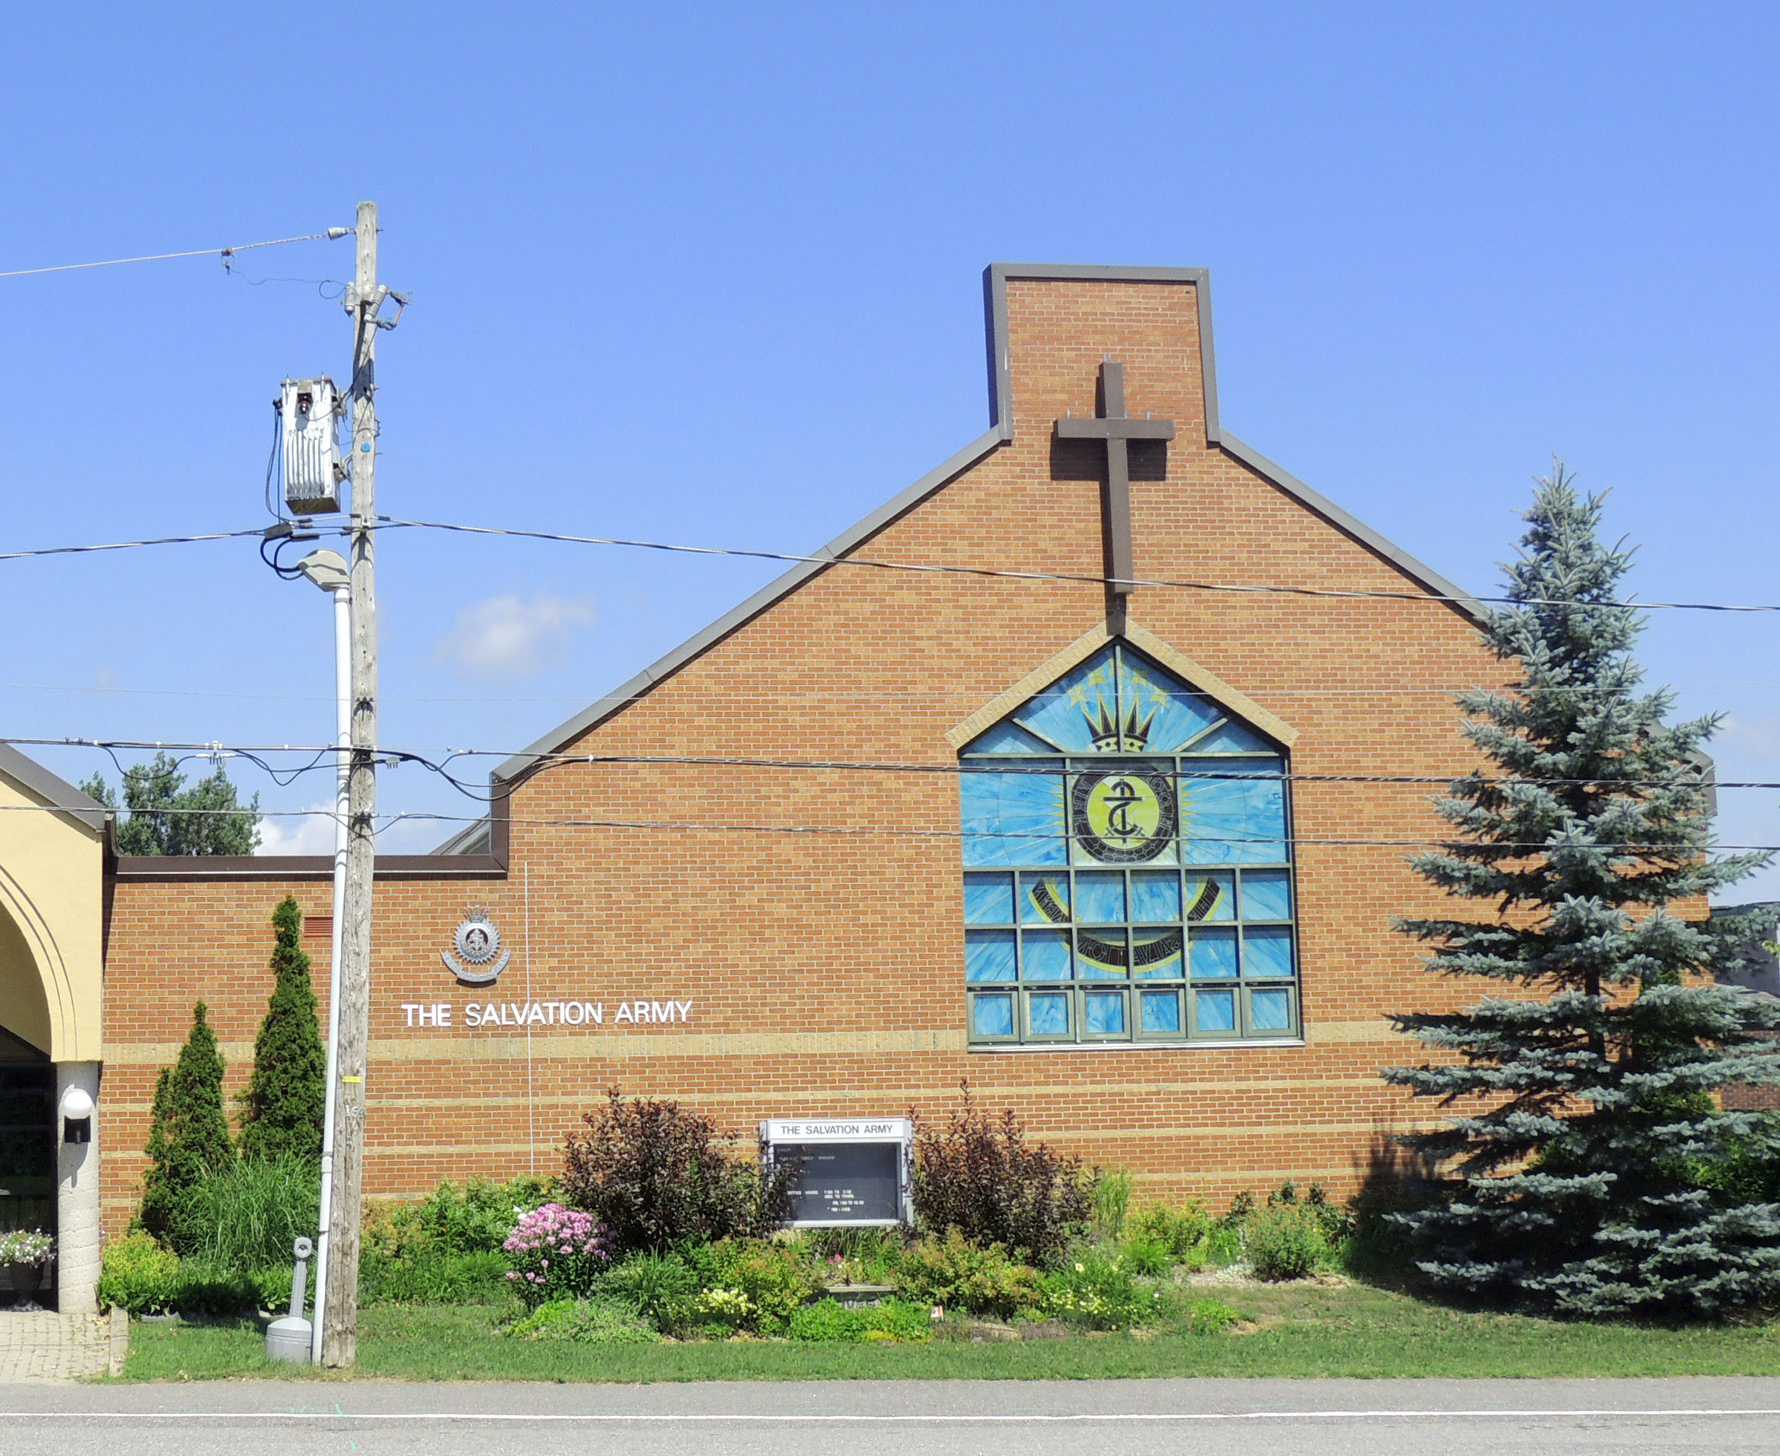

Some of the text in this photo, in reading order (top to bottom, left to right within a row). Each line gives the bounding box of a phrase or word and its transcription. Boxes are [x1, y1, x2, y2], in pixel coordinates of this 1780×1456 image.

[400, 1000, 693, 1027] THE SALVATION ARMY
[781, 1124, 893, 1135] THE SALVATION ARMY
